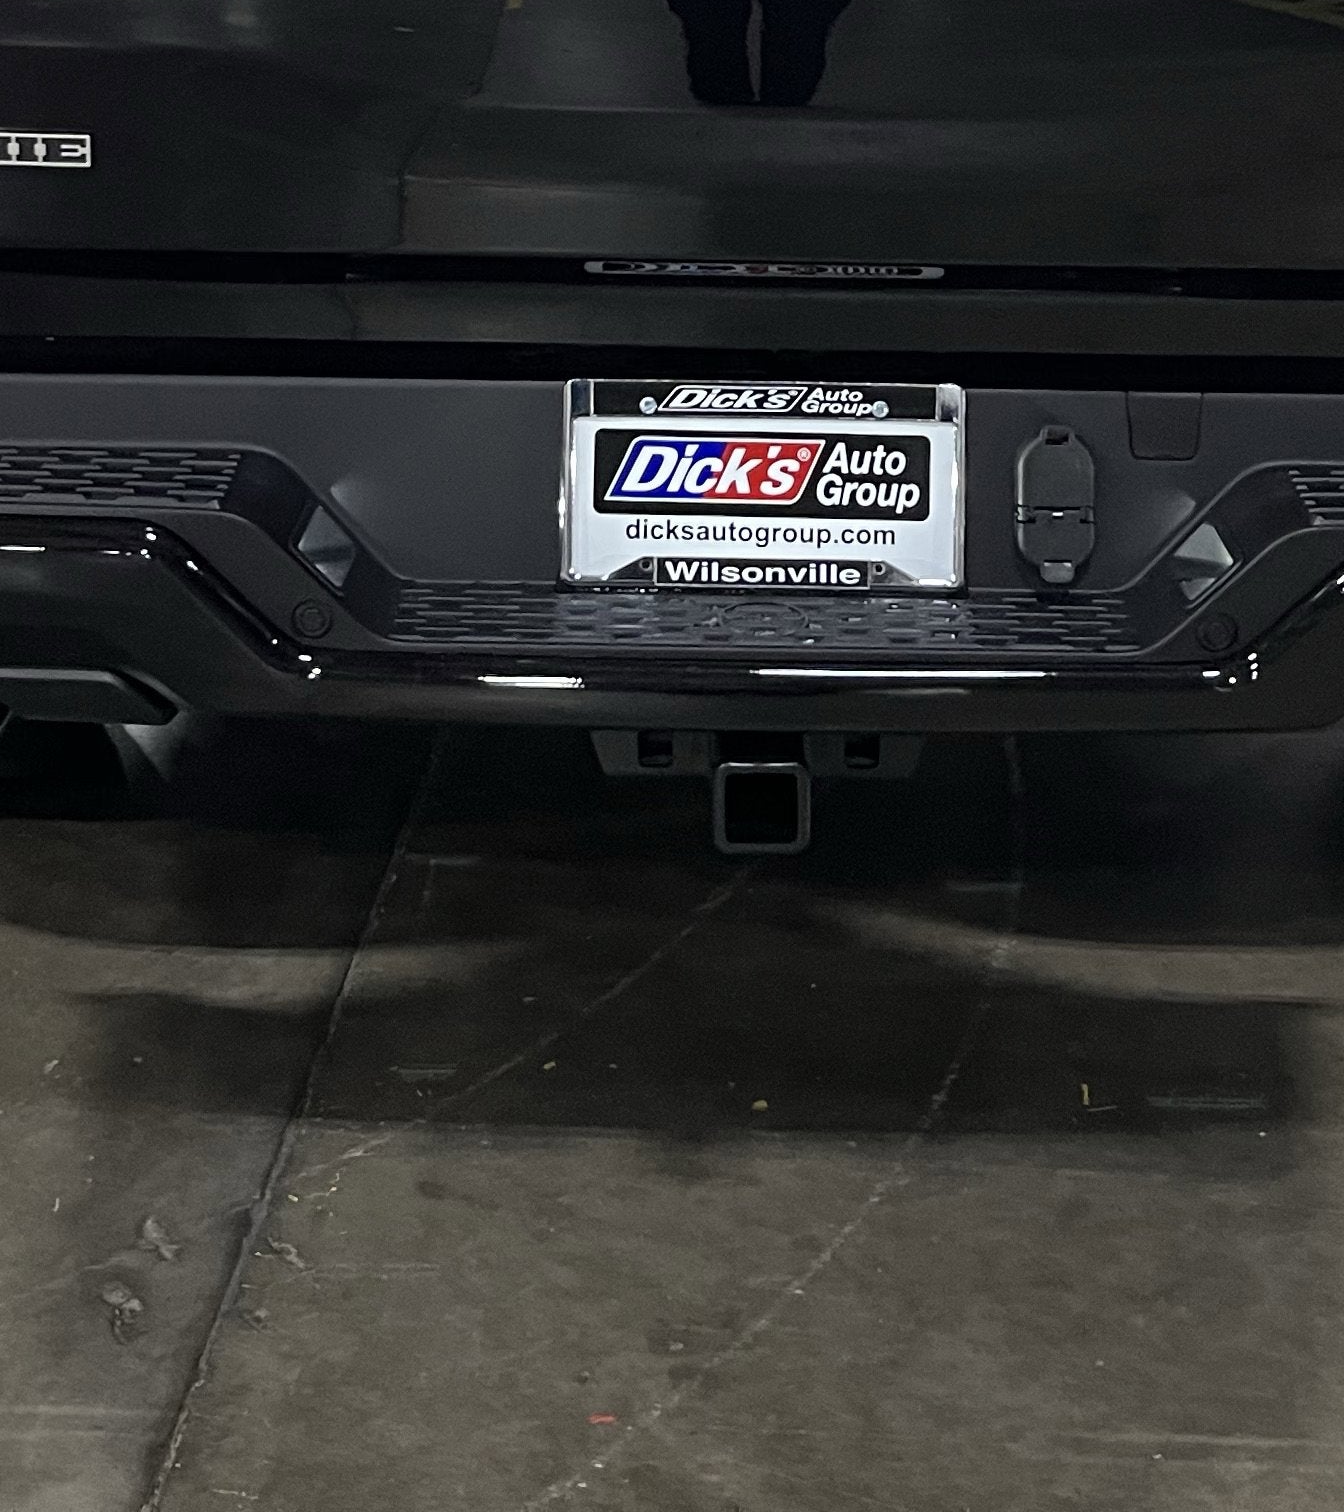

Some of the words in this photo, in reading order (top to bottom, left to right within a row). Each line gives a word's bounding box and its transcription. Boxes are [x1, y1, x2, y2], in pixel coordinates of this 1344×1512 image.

[668, 387, 792, 411] Dick's
[800, 399, 875, 417] Group
[806, 387, 864, 402] Auto
[620, 444, 801, 497] Dick's
[821, 442, 907, 476] Auto
[815, 474, 921, 515] Group
[625, 519, 896, 549] dicksautogroup.com
[664, 560, 862, 586] Wilsonville
